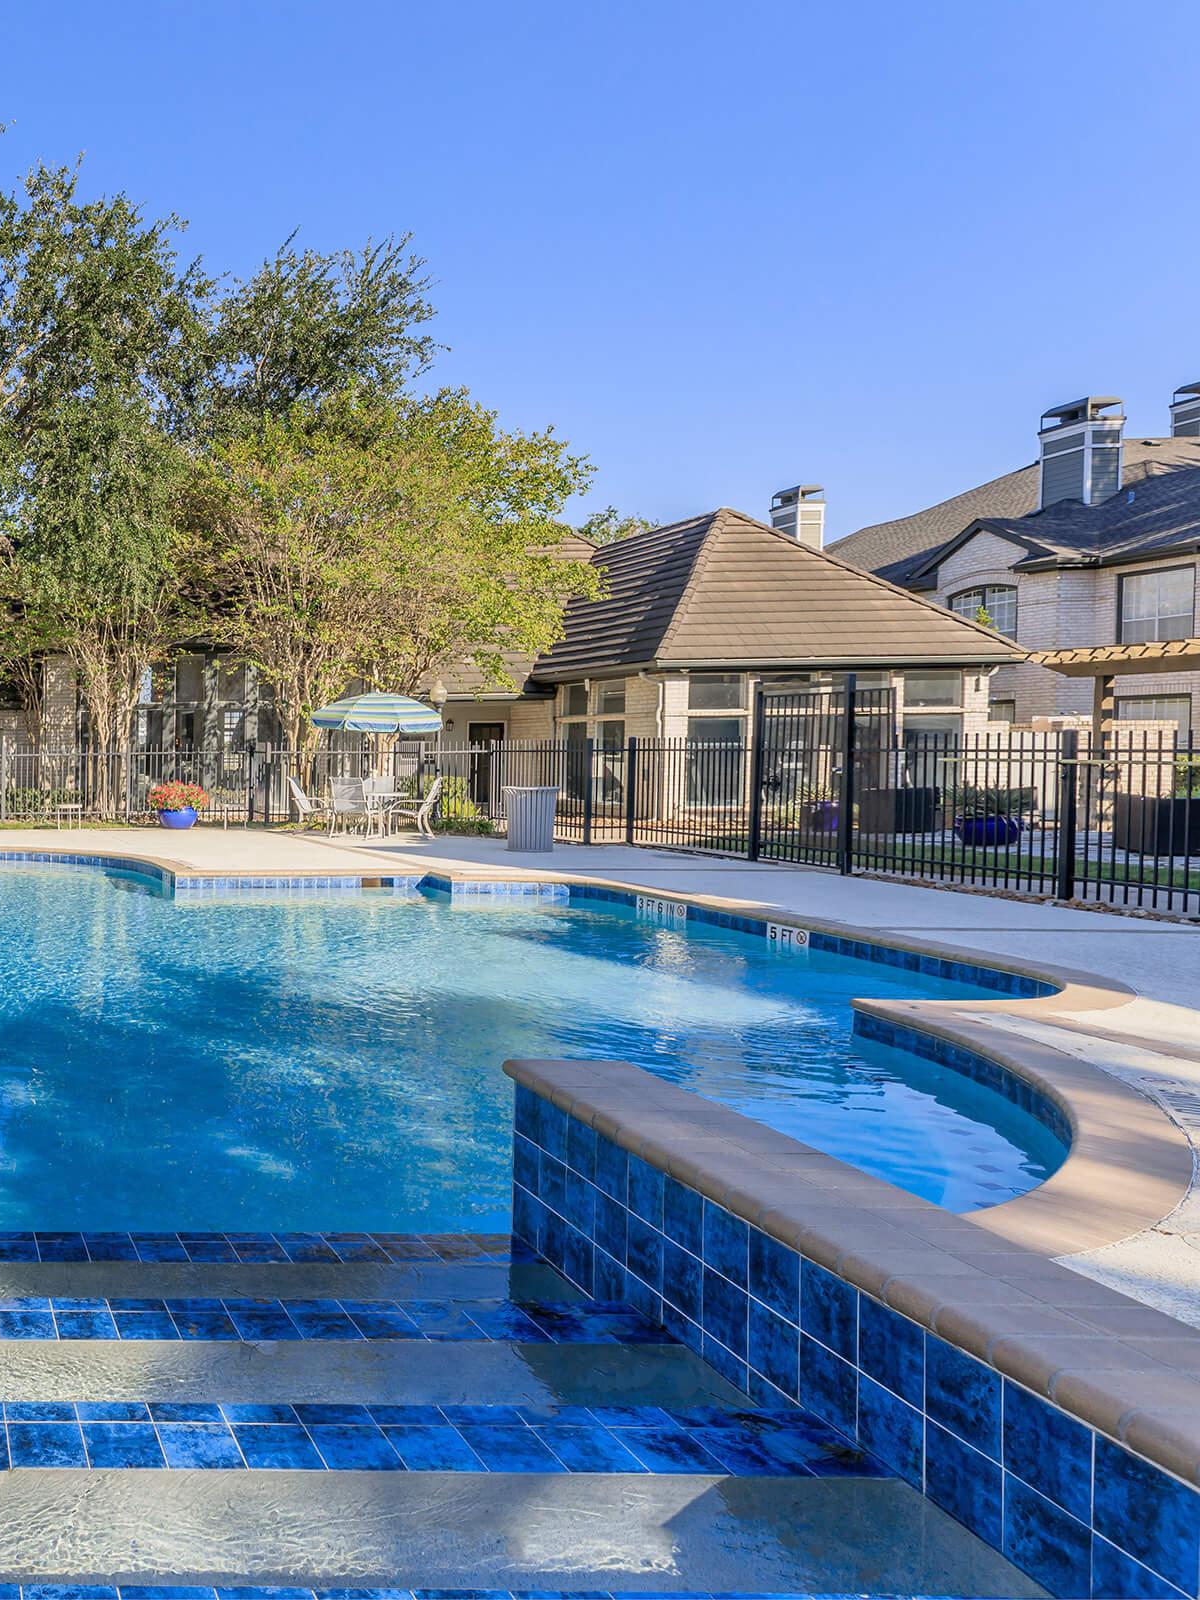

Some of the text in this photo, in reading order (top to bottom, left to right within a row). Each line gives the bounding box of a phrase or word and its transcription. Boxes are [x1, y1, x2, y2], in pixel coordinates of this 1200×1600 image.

[657, 902, 663, 913] 6
[770, 926, 793, 943] 5 FT
